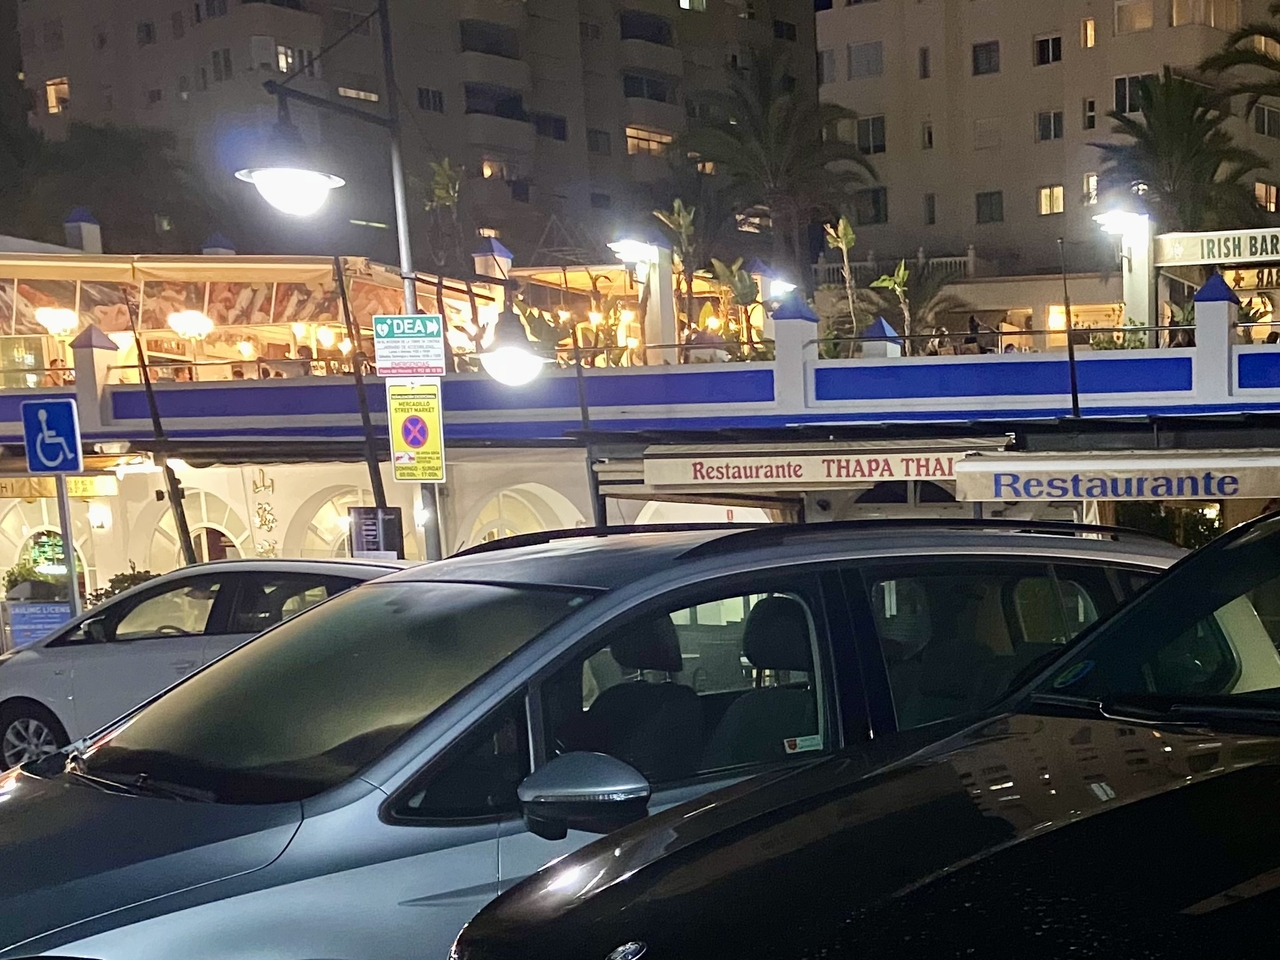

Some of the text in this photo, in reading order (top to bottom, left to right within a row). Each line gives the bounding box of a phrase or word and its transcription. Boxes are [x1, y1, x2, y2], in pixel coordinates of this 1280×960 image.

[1200, 234, 1280, 260] IRISH BAR
[393, 319, 426, 335] DEA
[692, 461, 803, 480] Restaurante
[822, 458, 894, 478] THAPA
[993, 471, 1239, 498] Restaurante
